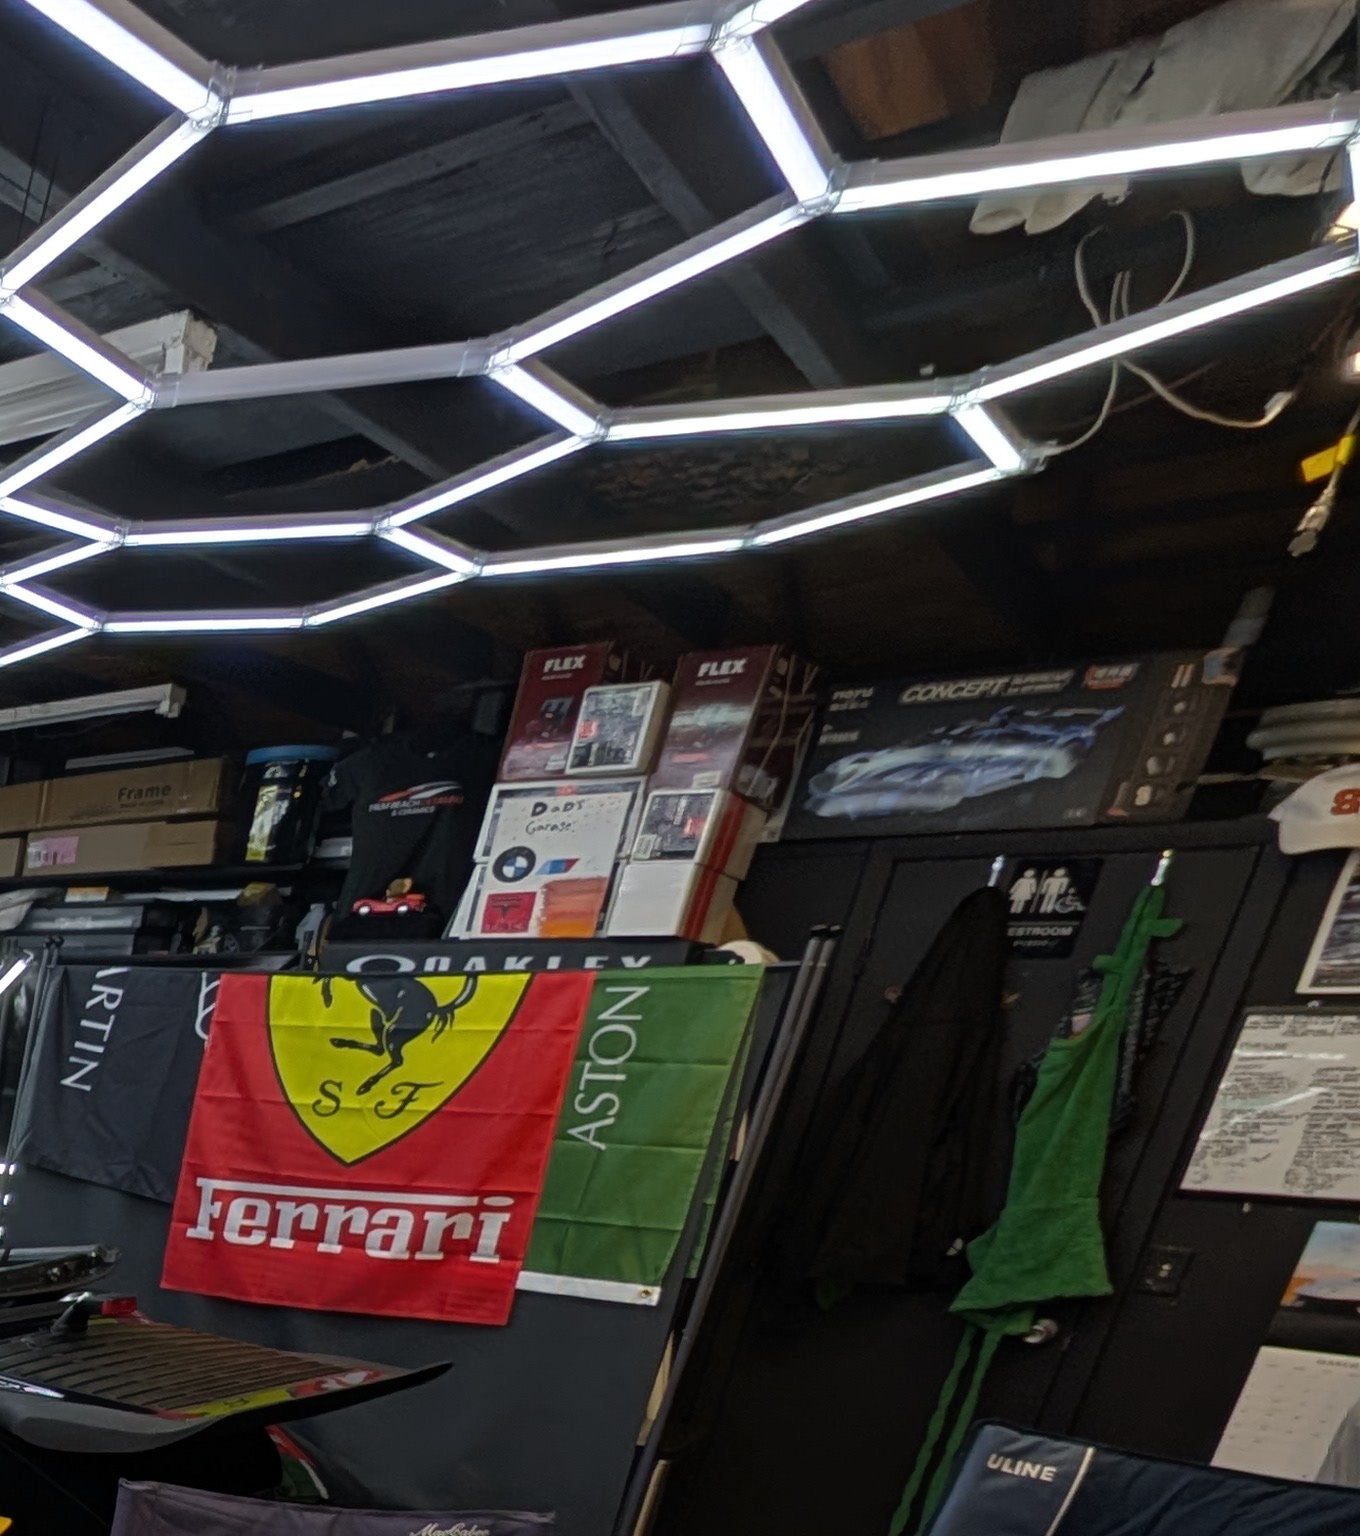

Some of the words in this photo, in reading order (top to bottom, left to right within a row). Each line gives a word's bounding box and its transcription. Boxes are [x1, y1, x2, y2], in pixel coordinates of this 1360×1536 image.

[542, 655, 587, 673] FLEX
[696, 657, 749, 678] FLEX
[900, 677, 1010, 705] CONCEPT
[117, 784, 172, 802] Frame
[1007, 926, 1074, 936] ESTROOM
[60, 966, 131, 1092] RTIN
[565, 984, 651, 1152] ASTON
[311, 1080, 344, 1119] S
[373, 1080, 445, 1121] F
[186, 1177, 516, 1264] Ferrari
[987, 1453, 1057, 1484] ULINE
